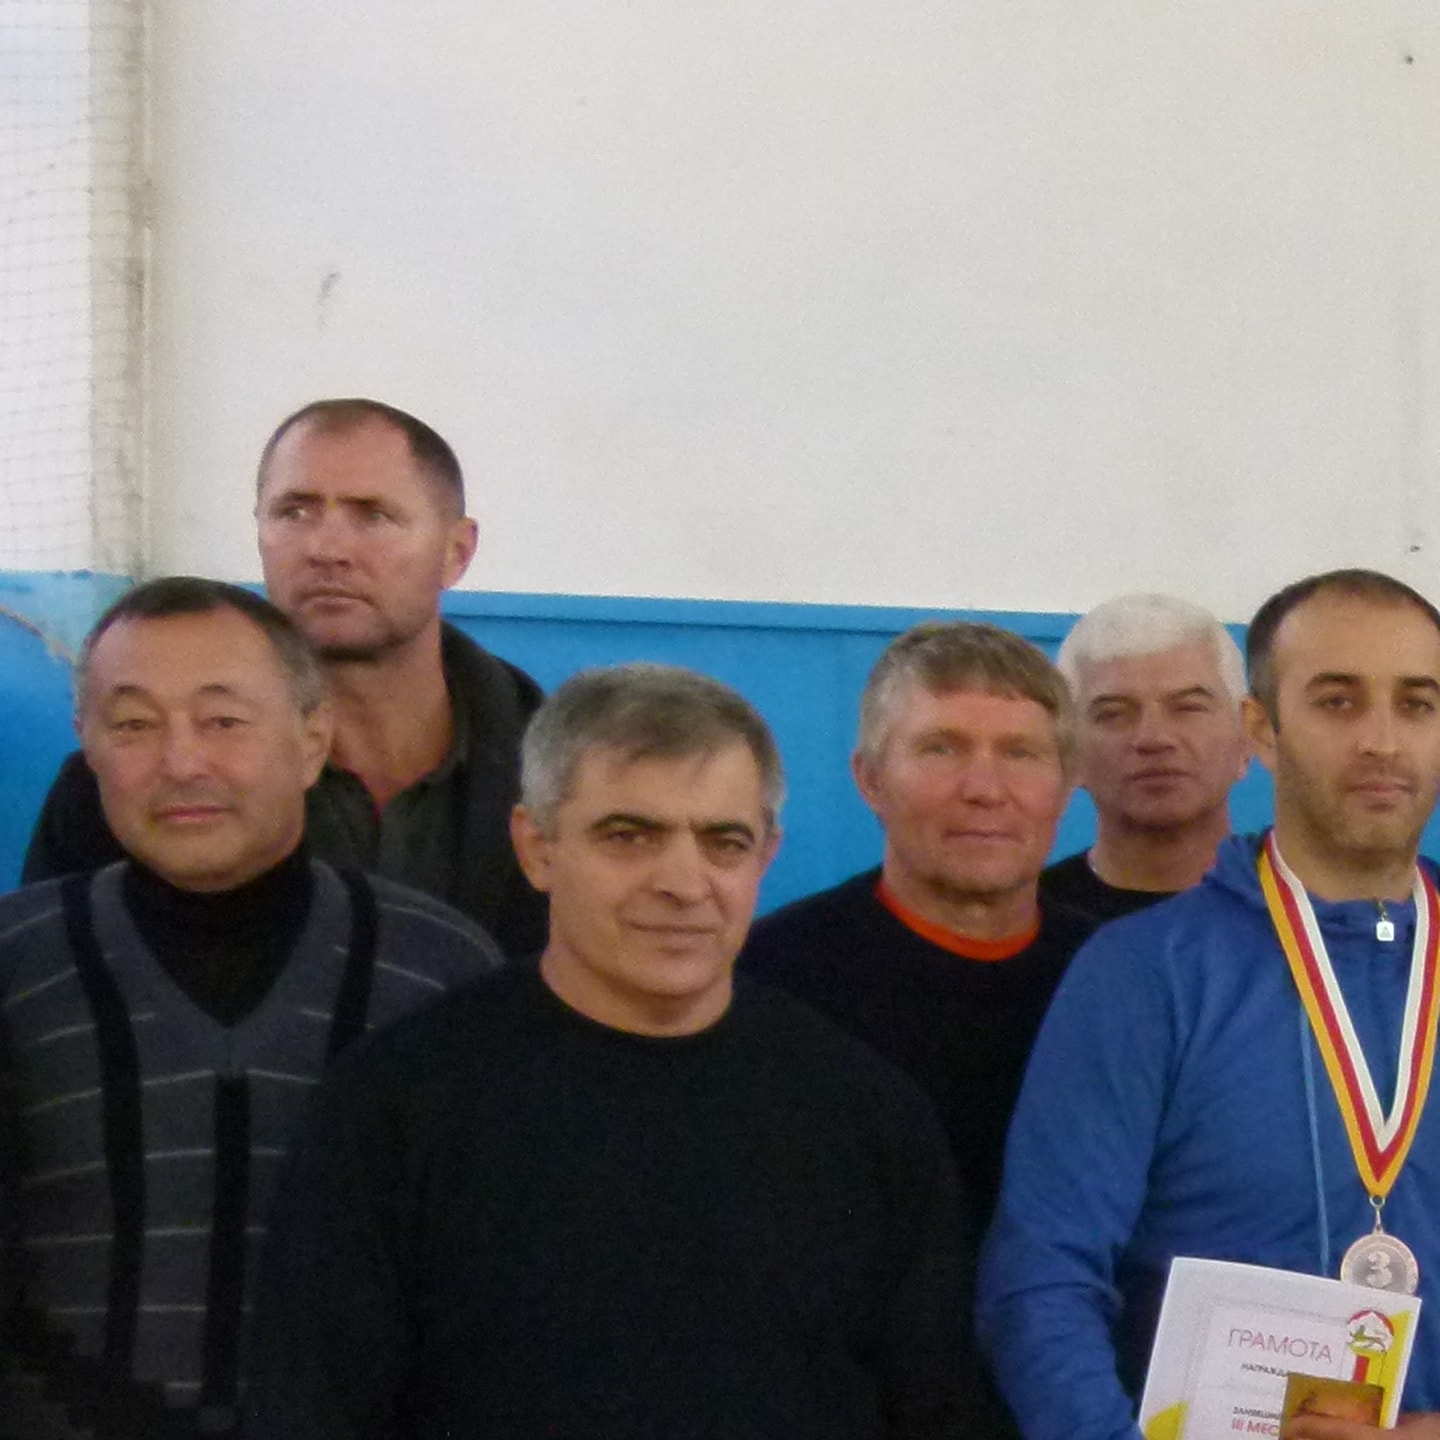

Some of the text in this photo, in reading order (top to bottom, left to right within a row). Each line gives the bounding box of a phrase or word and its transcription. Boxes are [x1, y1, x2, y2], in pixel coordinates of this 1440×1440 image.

[1228, 1328, 1332, 1363] ГРАМОТА
[1241, 1363, 1287, 1377] НАГРАЖД
[1246, 1420, 1280, 1436] МЕС
